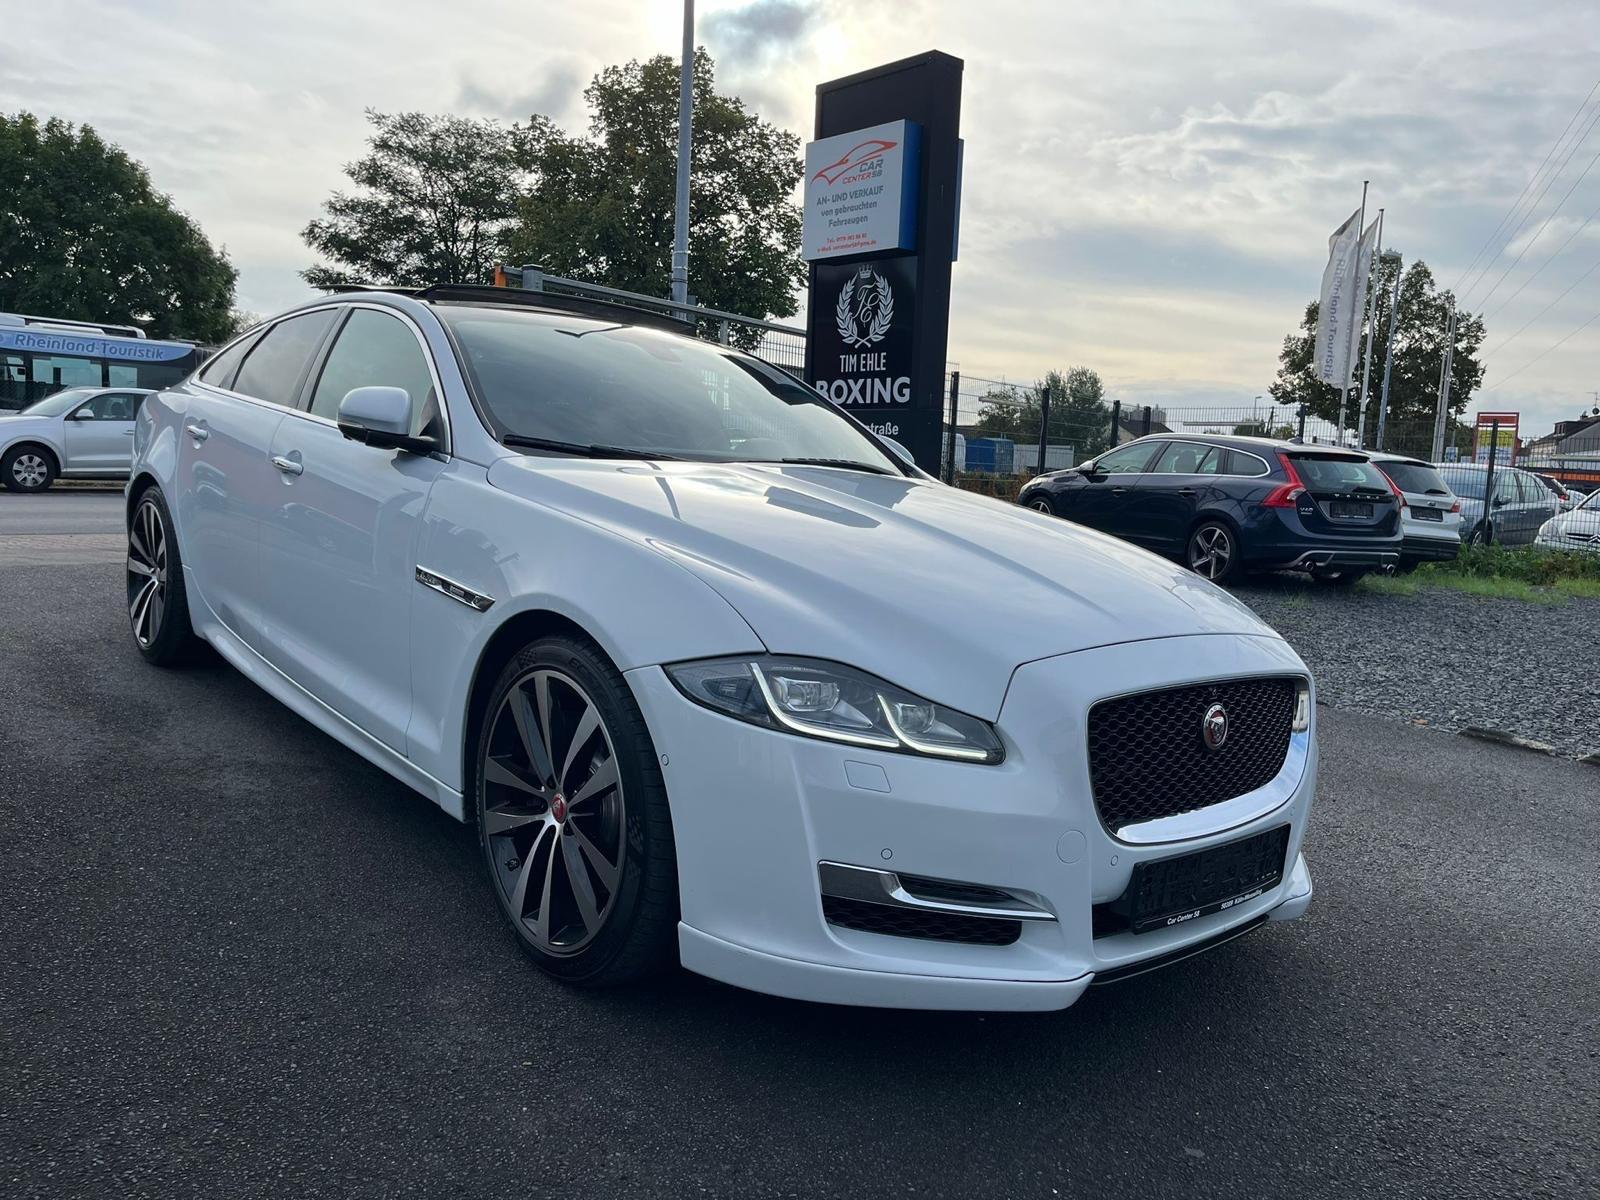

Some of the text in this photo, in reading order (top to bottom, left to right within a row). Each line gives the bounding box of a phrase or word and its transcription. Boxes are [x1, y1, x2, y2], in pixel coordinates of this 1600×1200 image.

[860, 158, 884, 173] CAR
[816, 185, 884, 206] AN- UND VERKAUF
[820, 201, 878, 217] von gebrauchten
[828, 215, 869, 228] Fahrzeugen
[14, 333, 164, 361] Rheinland-Touristik
[839, 351, 887, 373] TIM EHLE
[815, 376, 911, 405] BOXING
[865, 421, 899, 435] traße
[1167, 917, 1177, 926] Car
[1176, 912, 1194, 923] Center
